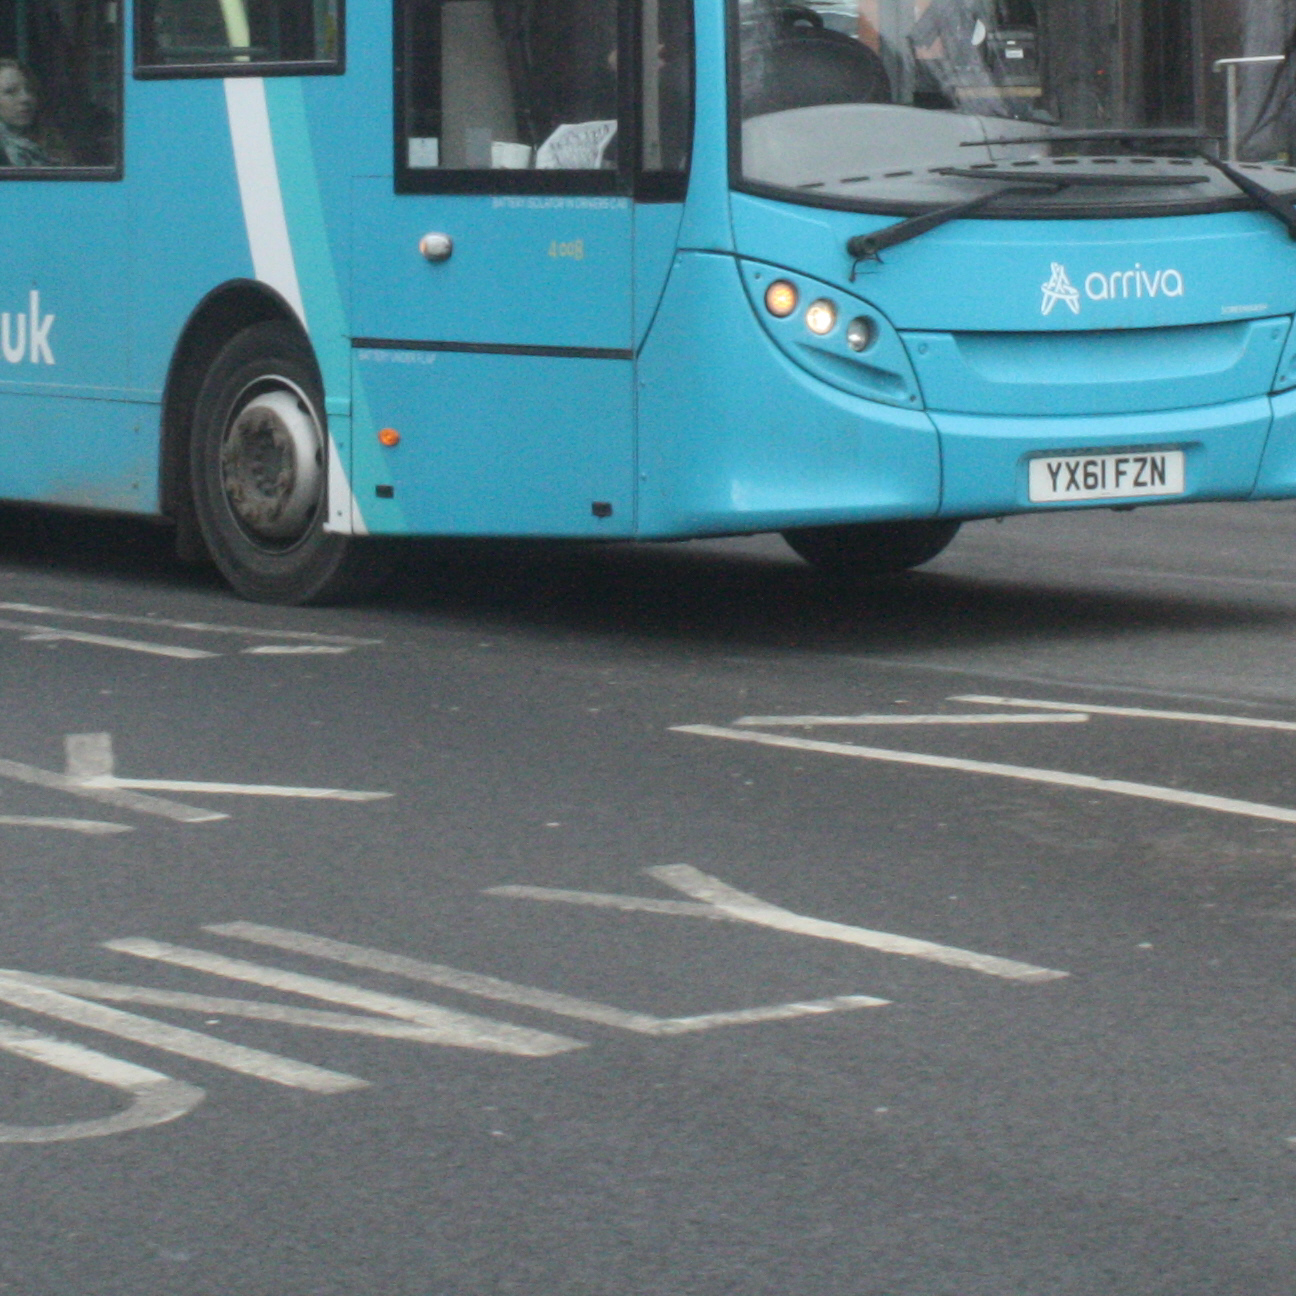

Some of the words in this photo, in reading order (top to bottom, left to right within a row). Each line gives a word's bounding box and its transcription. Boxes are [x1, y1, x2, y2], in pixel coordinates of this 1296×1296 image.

[548, 238, 585, 262] 4008
[1084, 262, 1184, 300] arriva
[1046, 459, 1106, 493] YX61
[1114, 455, 1167, 487] FZN
